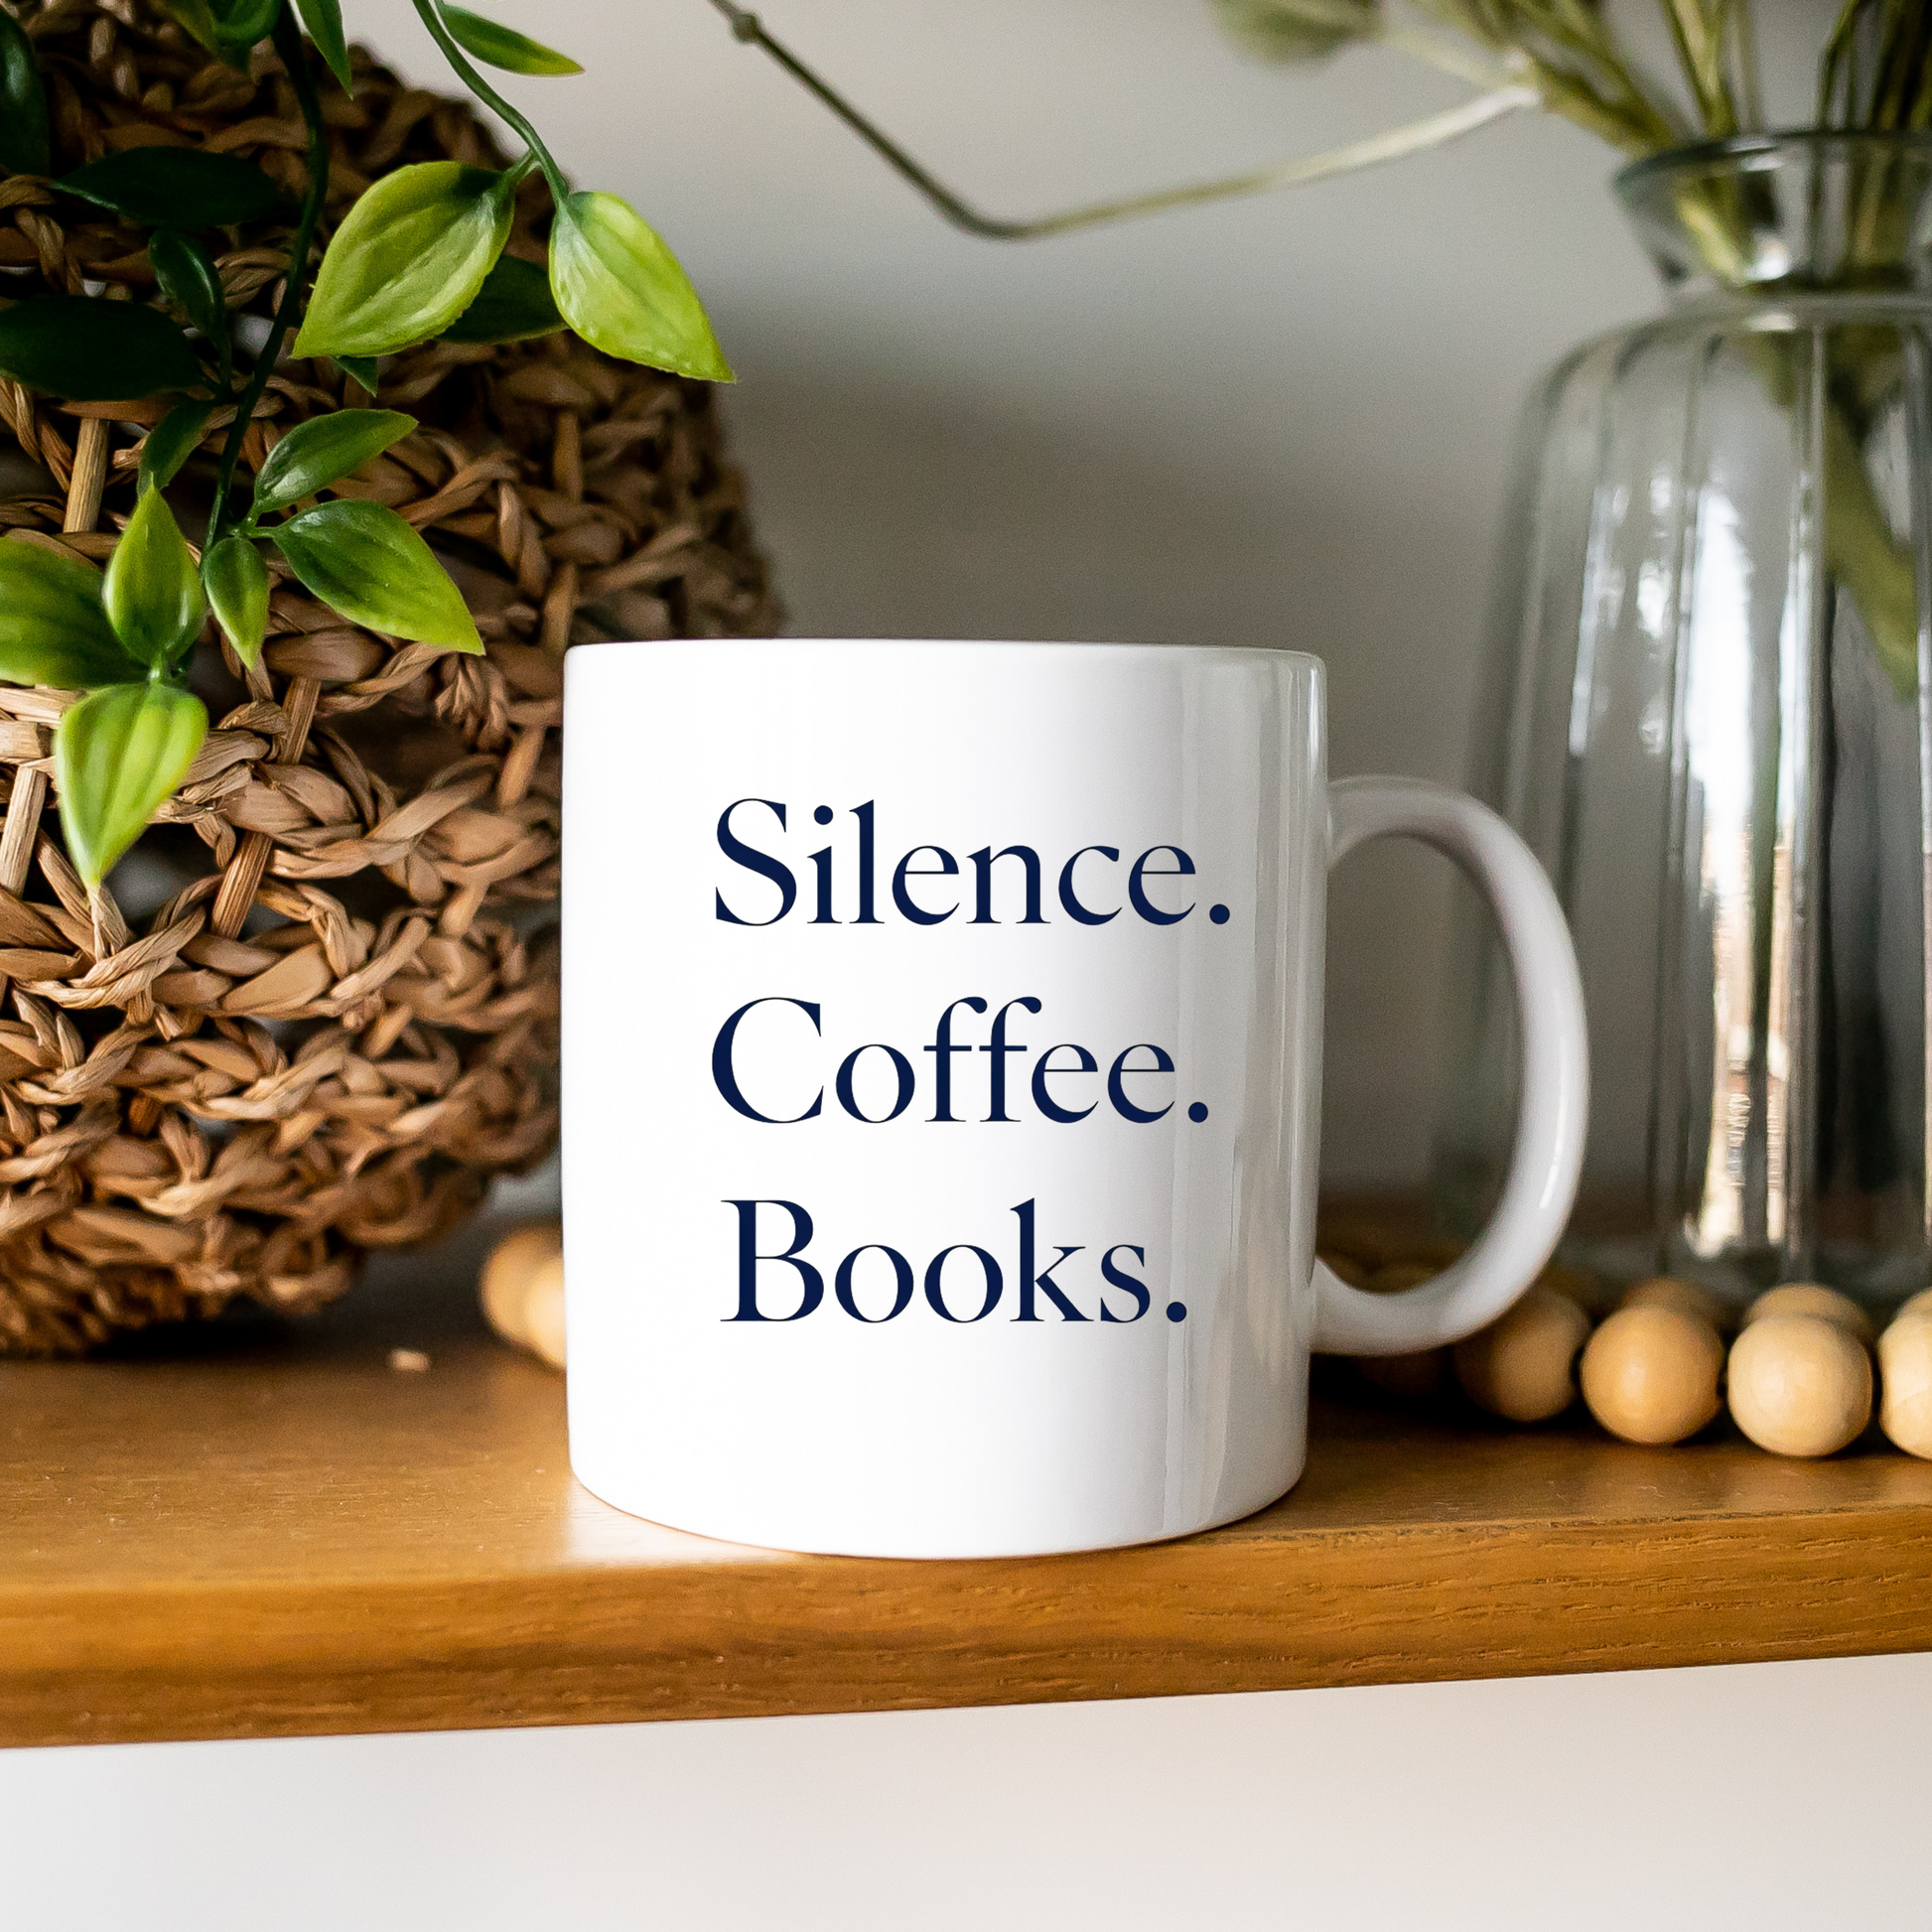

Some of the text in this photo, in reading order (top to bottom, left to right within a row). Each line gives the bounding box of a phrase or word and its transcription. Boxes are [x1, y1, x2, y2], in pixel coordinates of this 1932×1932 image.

[715, 798, 1231, 926] Silence.
[711, 996, 1209, 1124] Coffee.
[720, 1197, 1187, 1323] Books.
